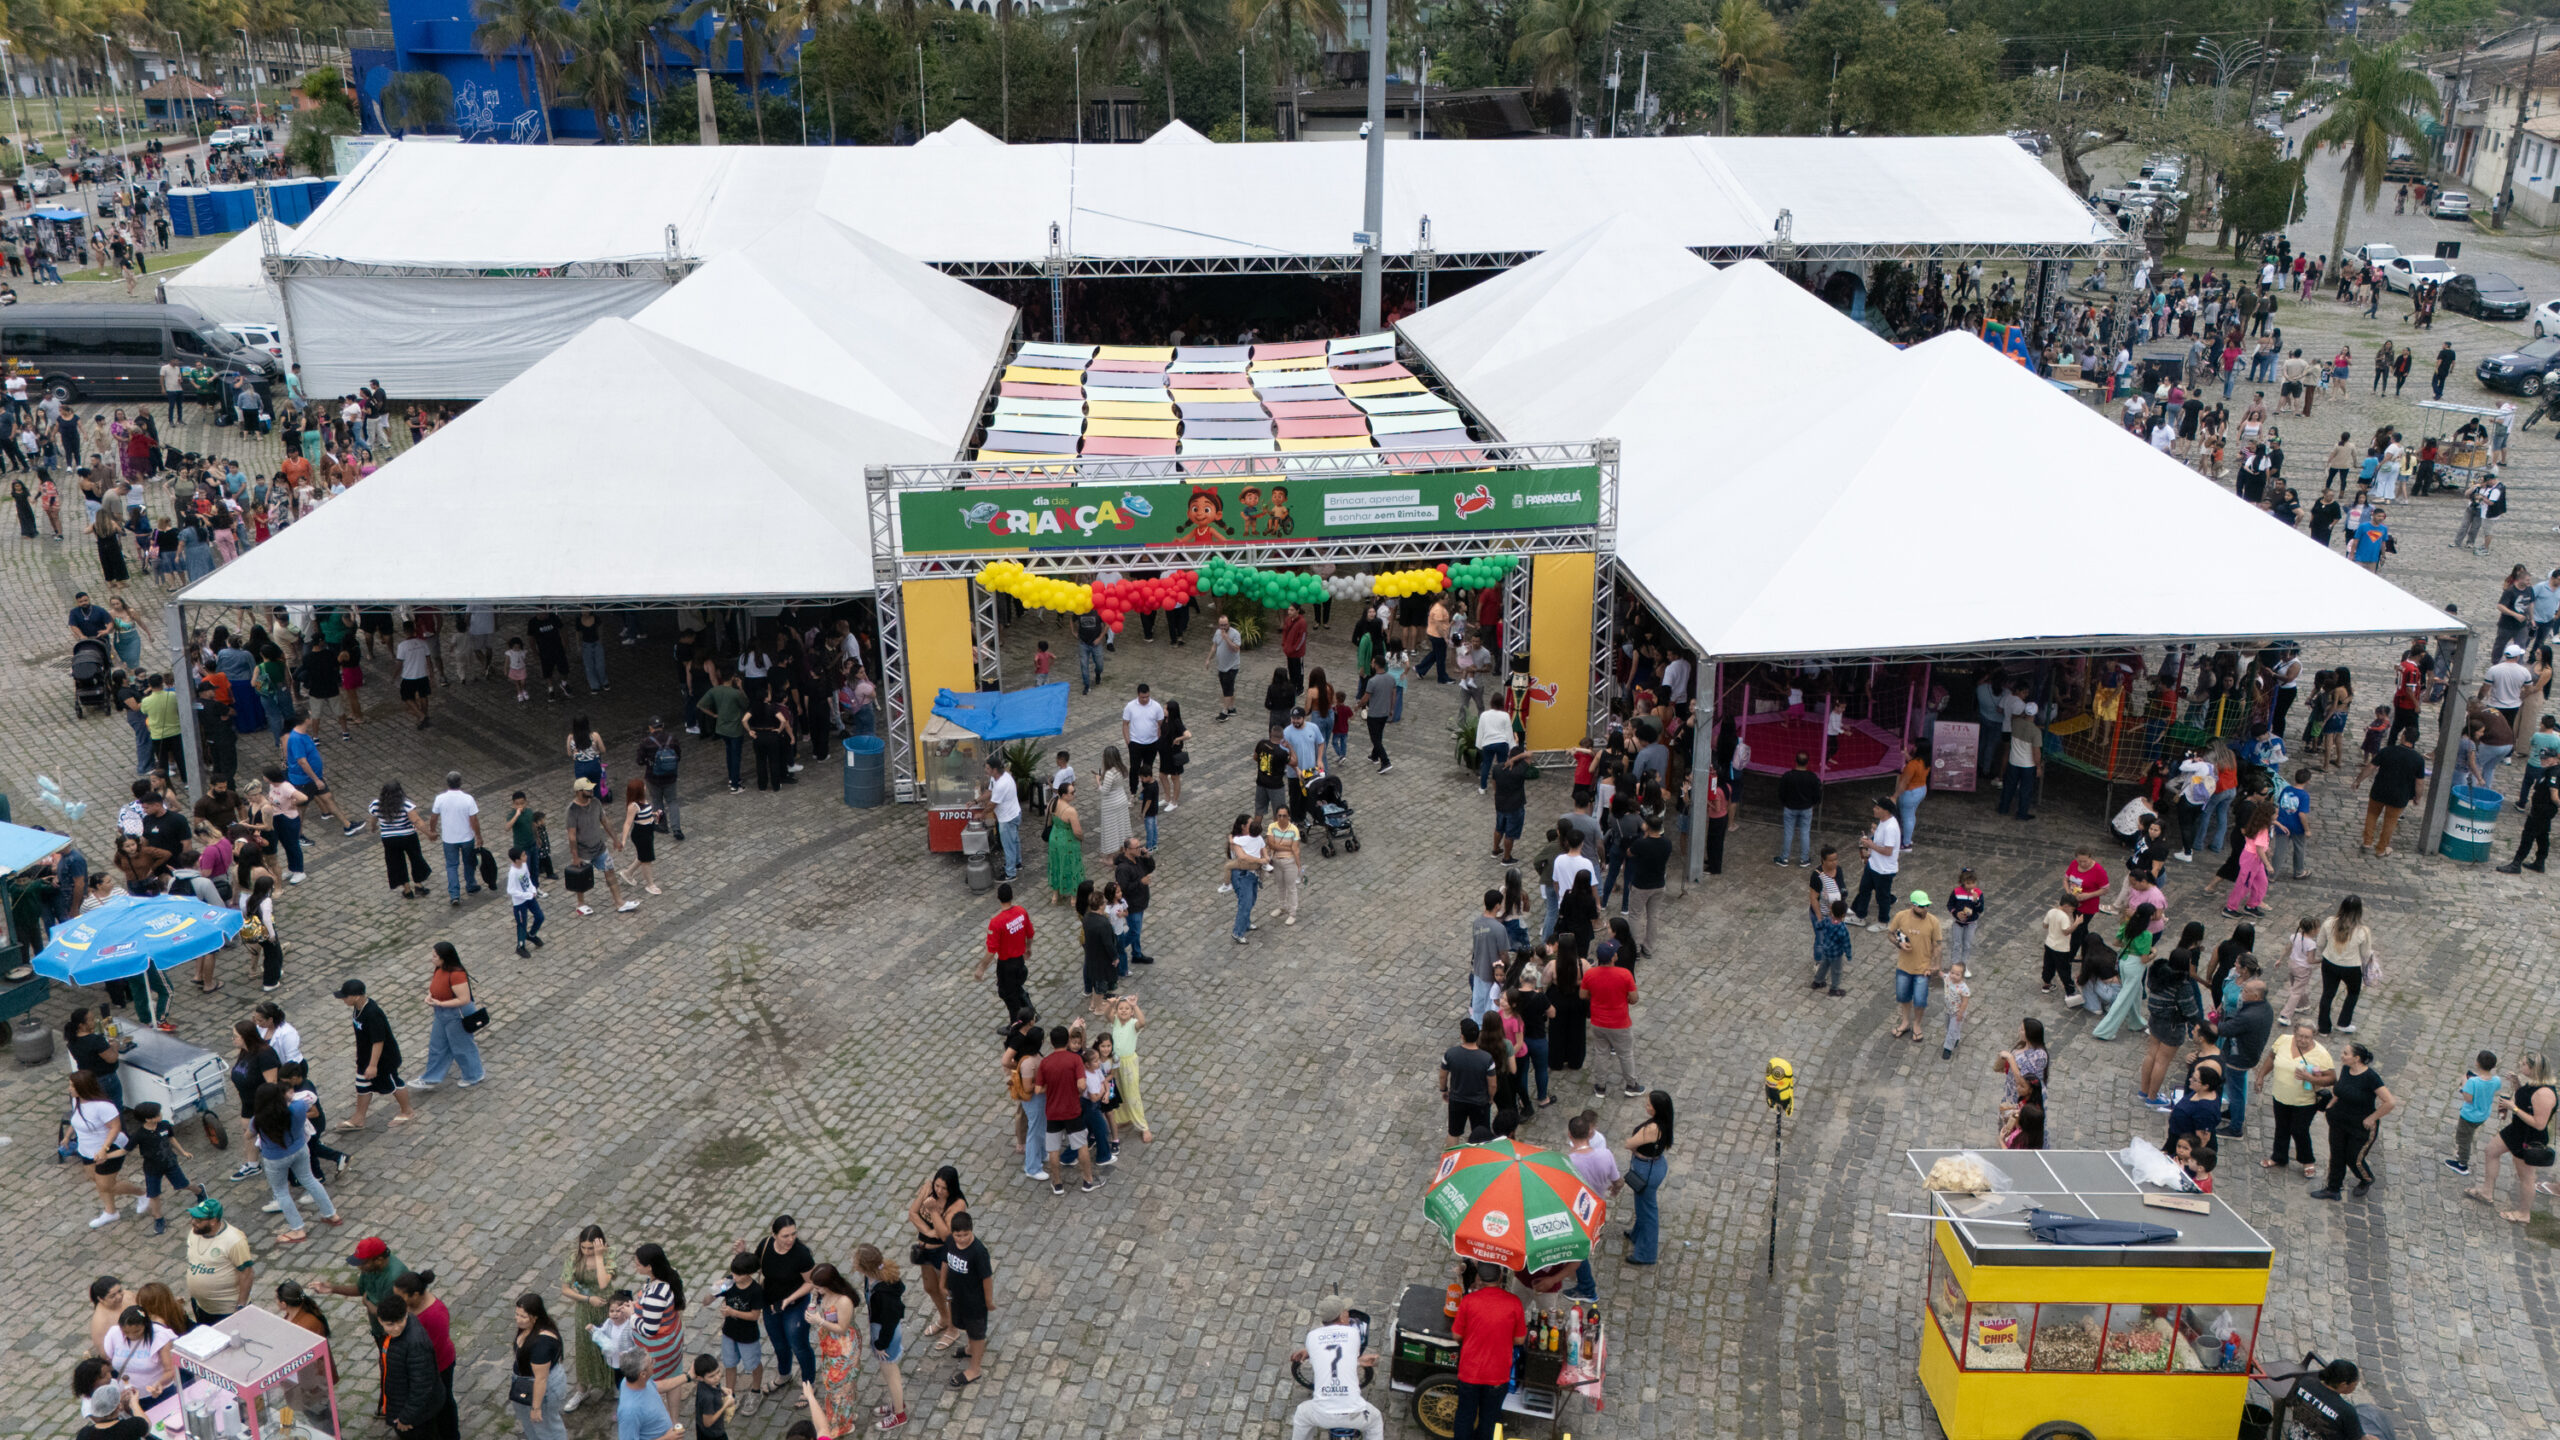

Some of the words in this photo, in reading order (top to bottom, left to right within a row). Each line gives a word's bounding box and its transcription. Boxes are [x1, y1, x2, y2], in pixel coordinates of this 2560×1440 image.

[1033, 496, 1050, 506] dia
[1051, 496, 1070, 505] das
[1329, 497, 1367, 506] Brincar,
[1369, 494, 1415, 504] aprender
[1525, 489, 1582, 505] PARANAGUÁ
[988, 500, 1136, 537] CRIANÇAS
[1338, 512, 1372, 521] sonhar
[1374, 511, 1396, 520] sem
[1397, 509, 1435, 518] limites.
[939, 811, 973, 820] PIPOCA
[1466, 1239, 1485, 1249] CLUBE
[1495, 1244, 1514, 1256] PESCA
[1472, 1247, 1507, 1261] VENETO
[1541, 1250, 1573, 1262] VENETO
[1983, 1318, 2013, 1327] BATATA
[1984, 1333, 2014, 1345] CHIPS
[1325, 1344, 1343, 1378] 7
[180, 1357, 239, 1396] CHURROS
[260, 1351, 315, 1390] CHURROS
